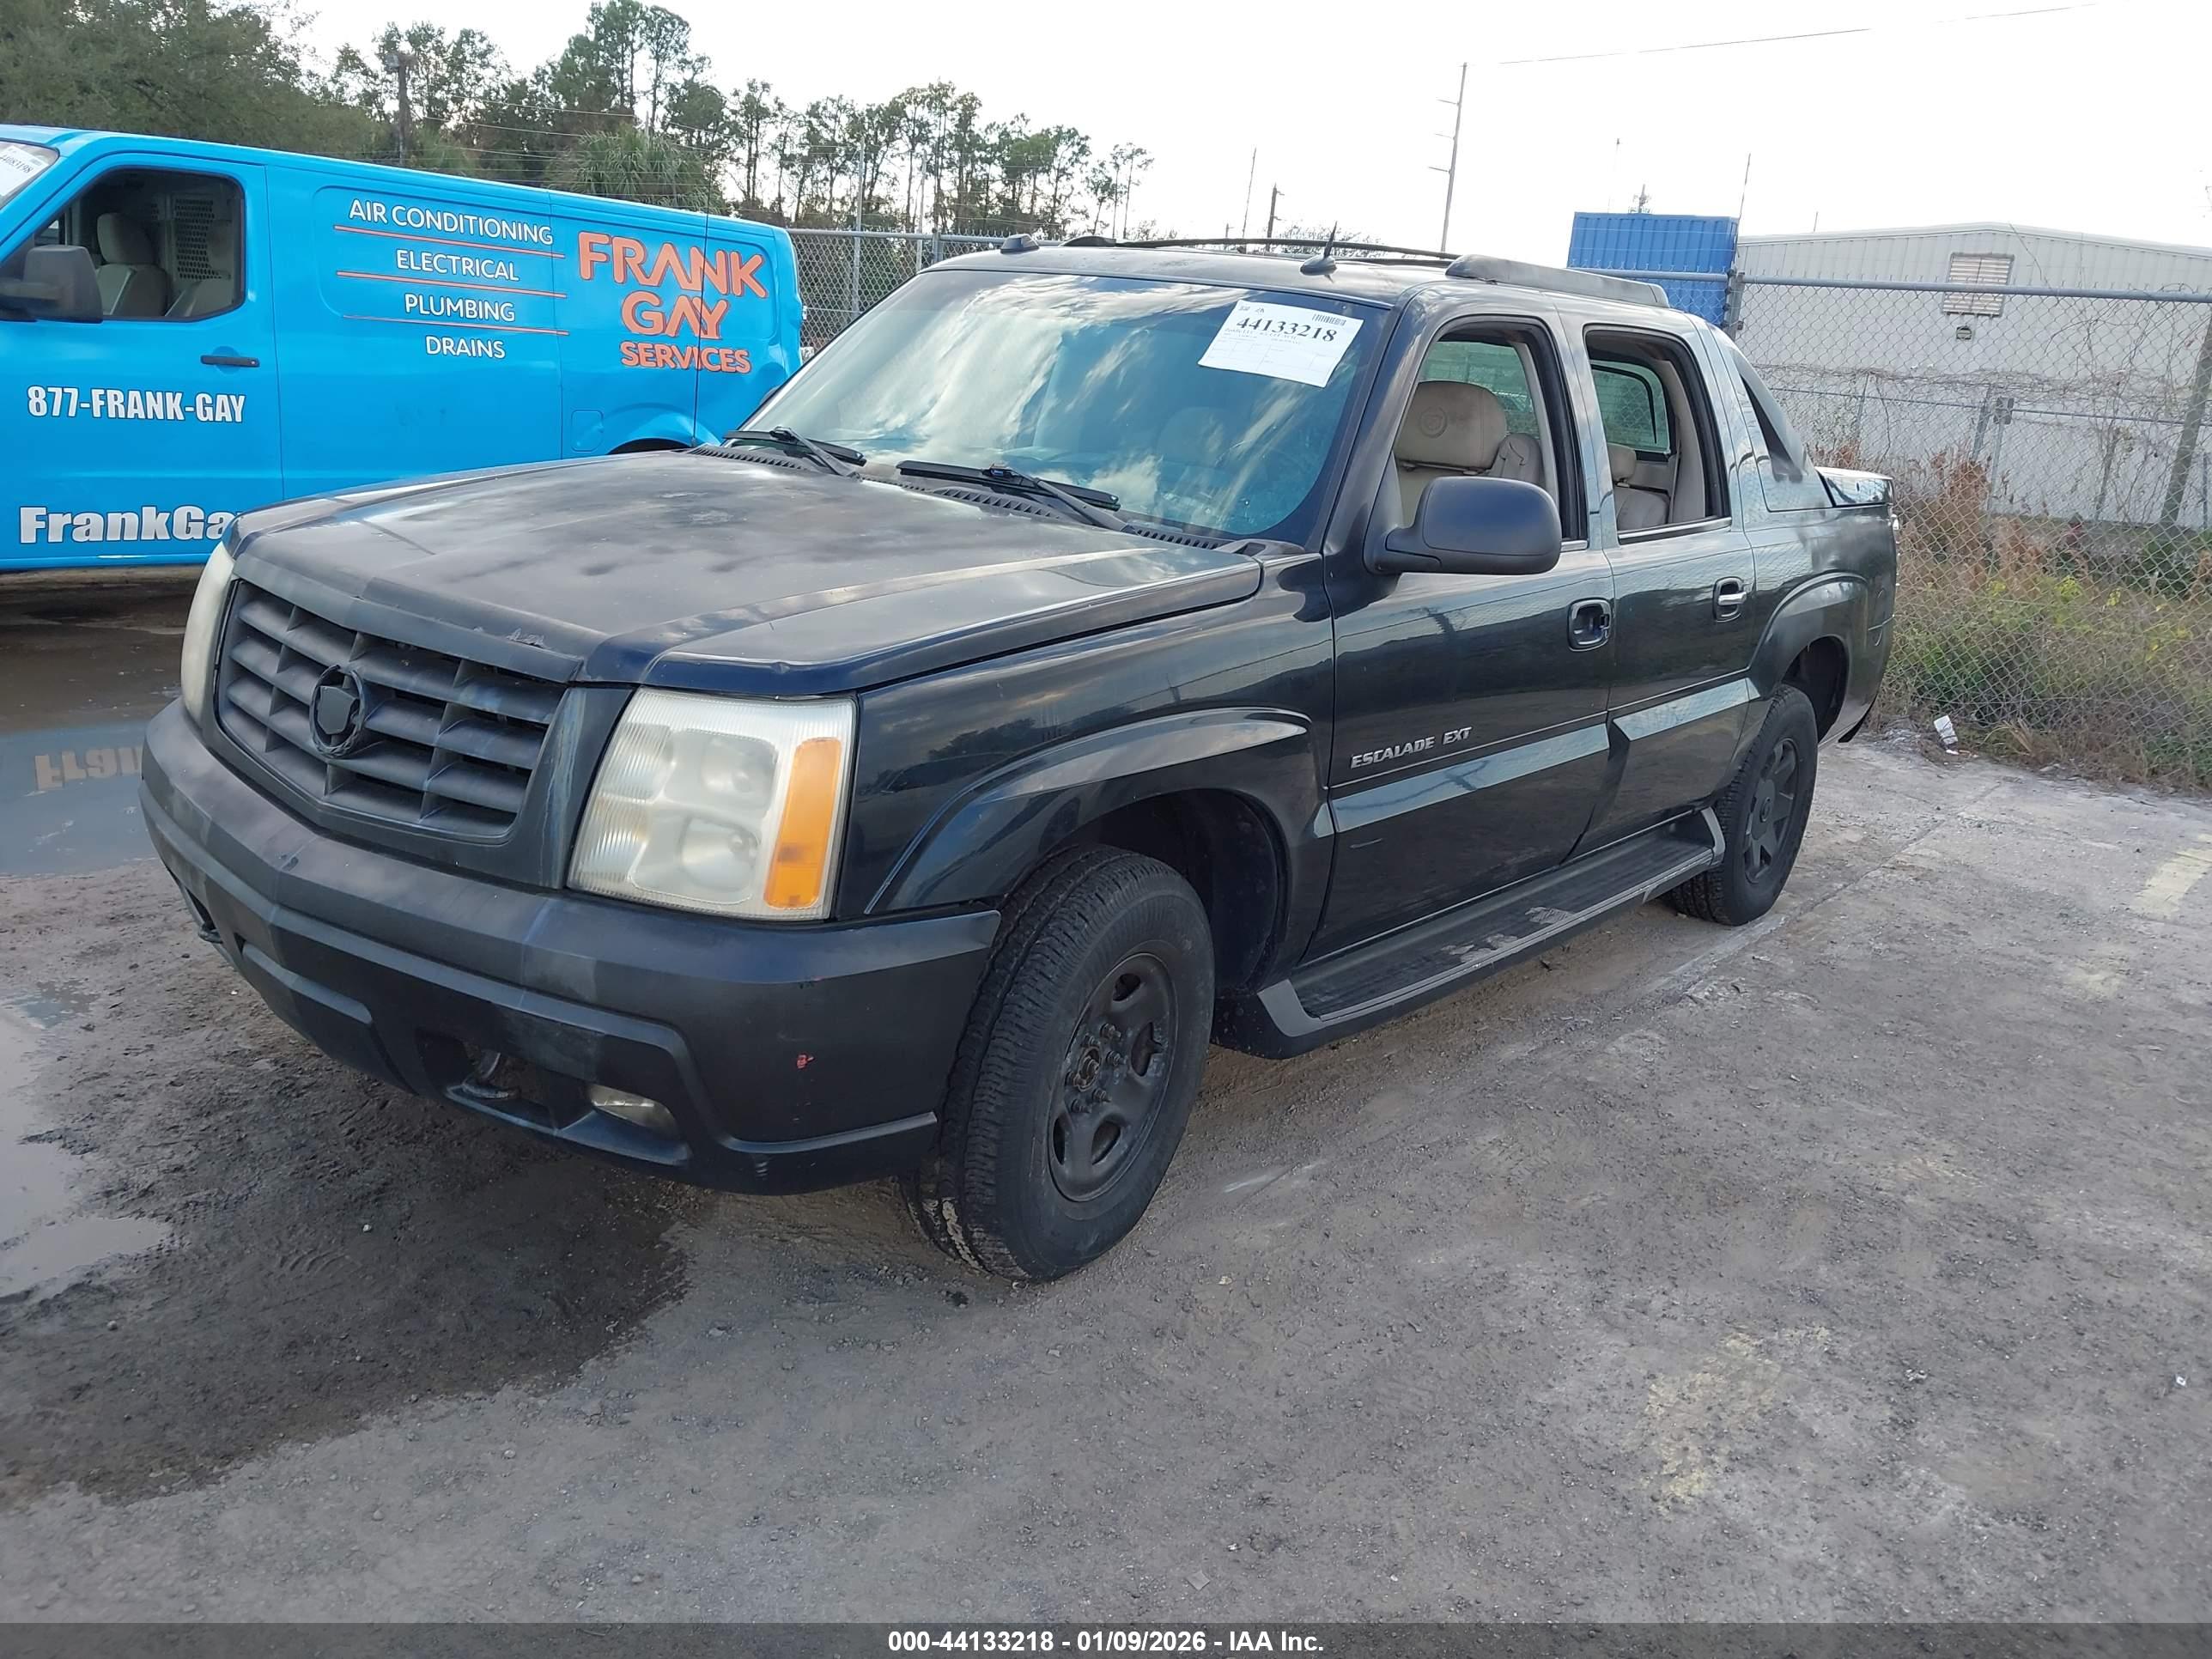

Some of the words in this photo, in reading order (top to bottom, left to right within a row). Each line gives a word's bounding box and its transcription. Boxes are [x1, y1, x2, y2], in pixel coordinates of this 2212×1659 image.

[349, 199, 387, 223] AIR
[392, 205, 553, 245] CONDITIONING
[396, 249, 520, 282] ELECTRICAL
[578, 231, 768, 298] FRANK
[404, 294, 515, 322] PLUMBING
[621, 290, 728, 340] GAY
[426, 336, 506, 359] DRAINS
[1237, 317, 1338, 342] 44133218
[620, 341, 751, 374] SERVICES
[27, 386, 246, 422] 877-FRANK-GAY
[20, 505, 242, 544] FrankGa
[1351, 736, 1435, 769] ESCALADE
[1443, 726, 1473, 744] EXT
